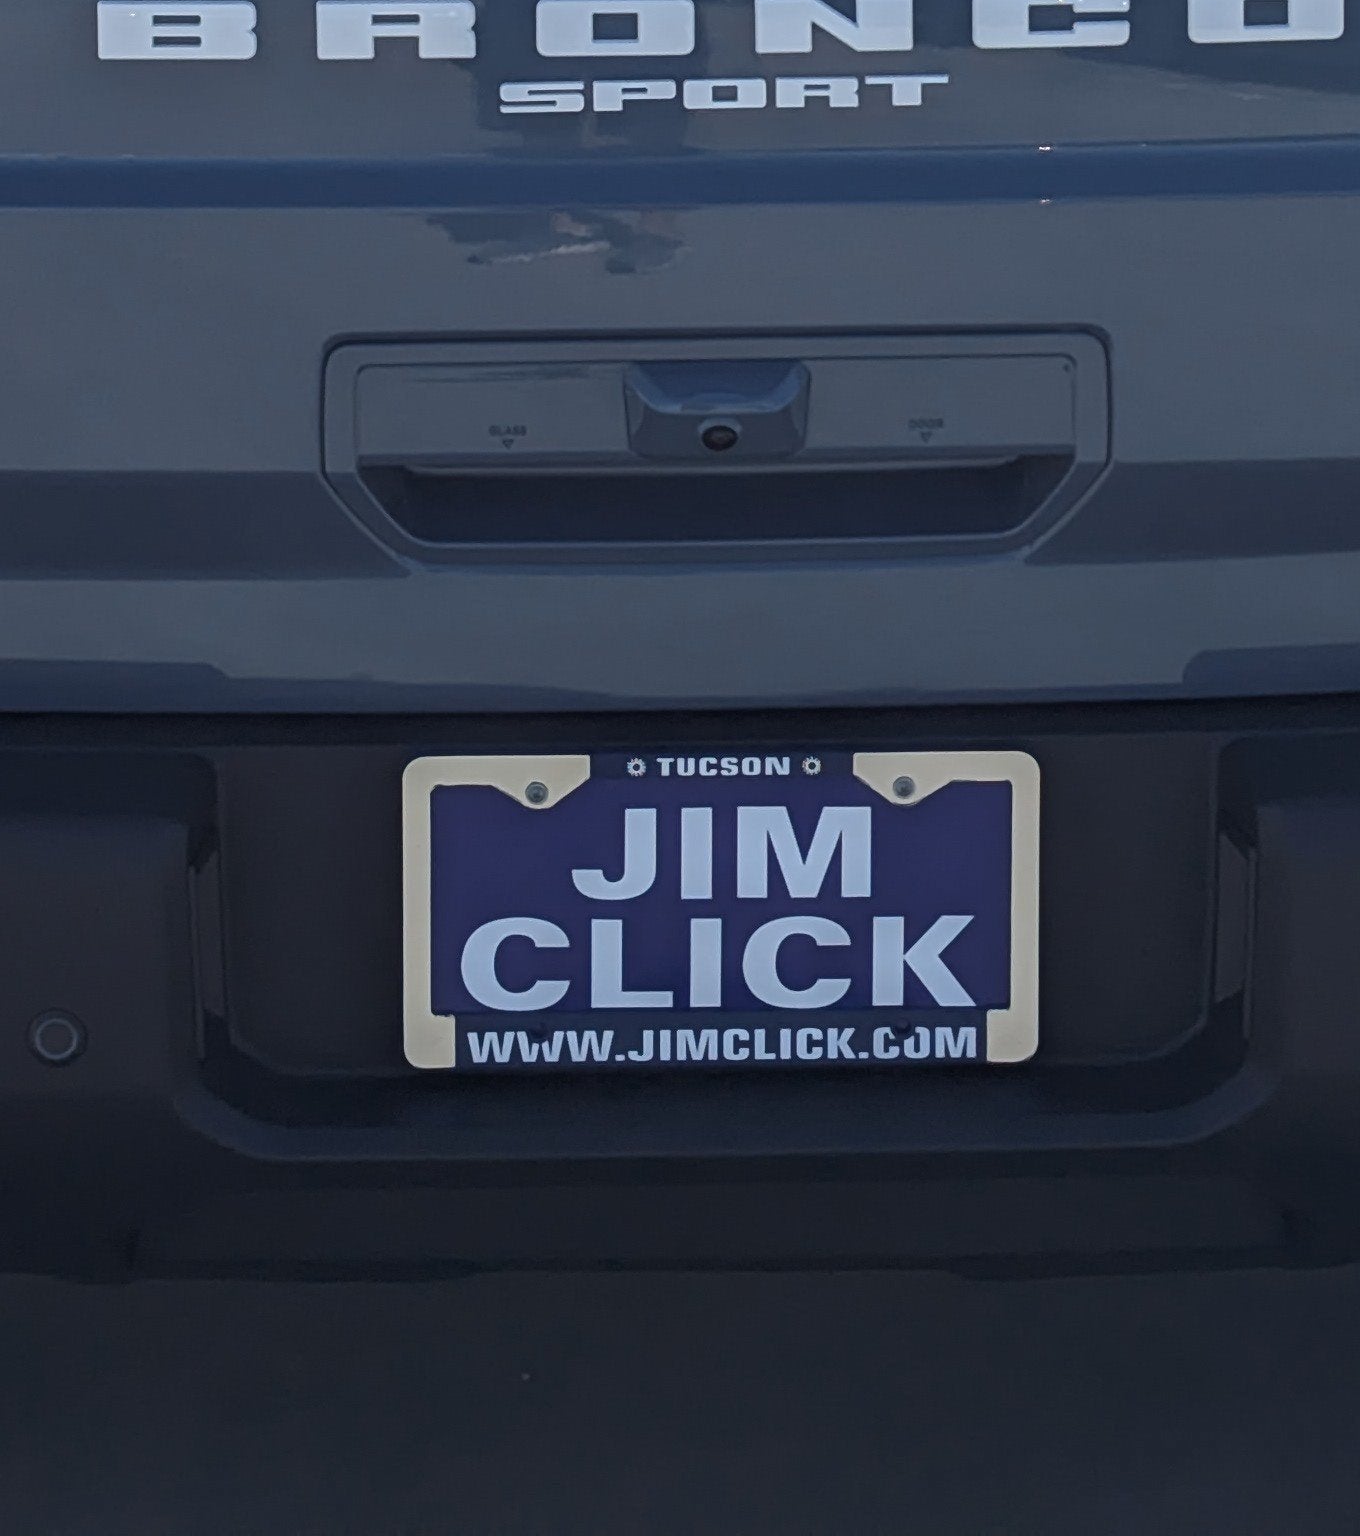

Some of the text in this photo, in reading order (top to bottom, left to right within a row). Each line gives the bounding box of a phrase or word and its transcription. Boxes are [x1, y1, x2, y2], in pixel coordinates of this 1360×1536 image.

[498, 75, 950, 115] SPORT
[655, 756, 792, 777] TUCSON
[570, 805, 873, 901] JIM
[459, 915, 978, 1012] CLICK
[465, 1025, 979, 1064] WWW.JIMCLICK.COM
